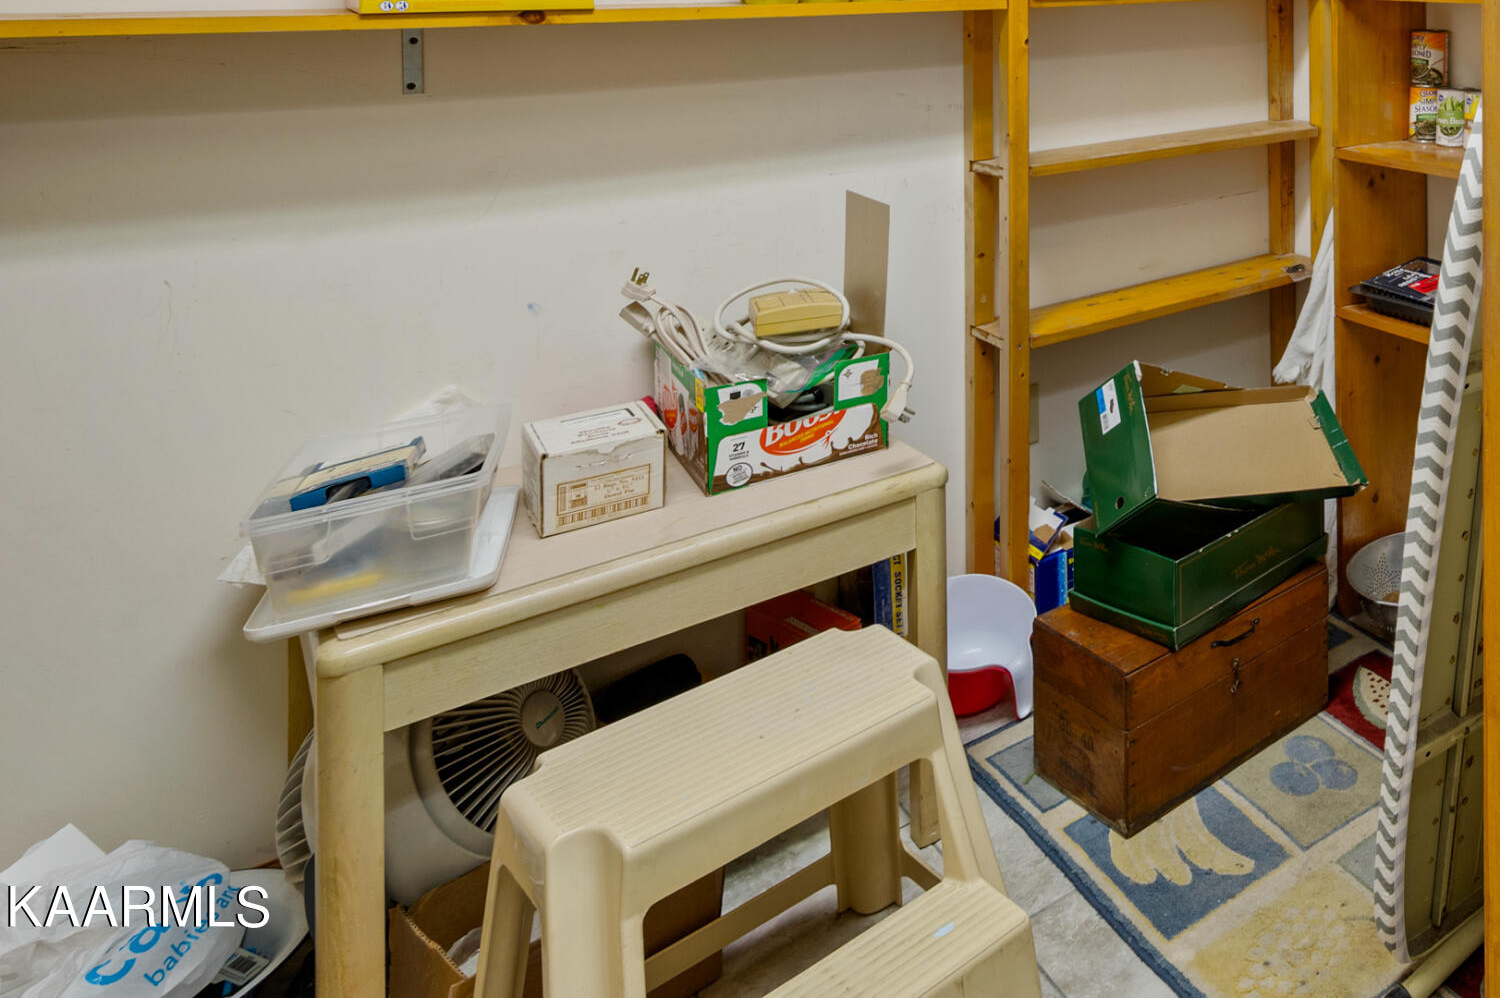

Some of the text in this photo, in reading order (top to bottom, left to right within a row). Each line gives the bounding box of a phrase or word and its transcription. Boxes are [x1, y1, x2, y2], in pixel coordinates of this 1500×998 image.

[865, 433, 878, 441] Rich
[733, 442, 746, 452] 27
[848, 438, 878, 450] Chocolate
[733, 465, 743, 473] NO
[893, 571, 903, 609] SOCKET
